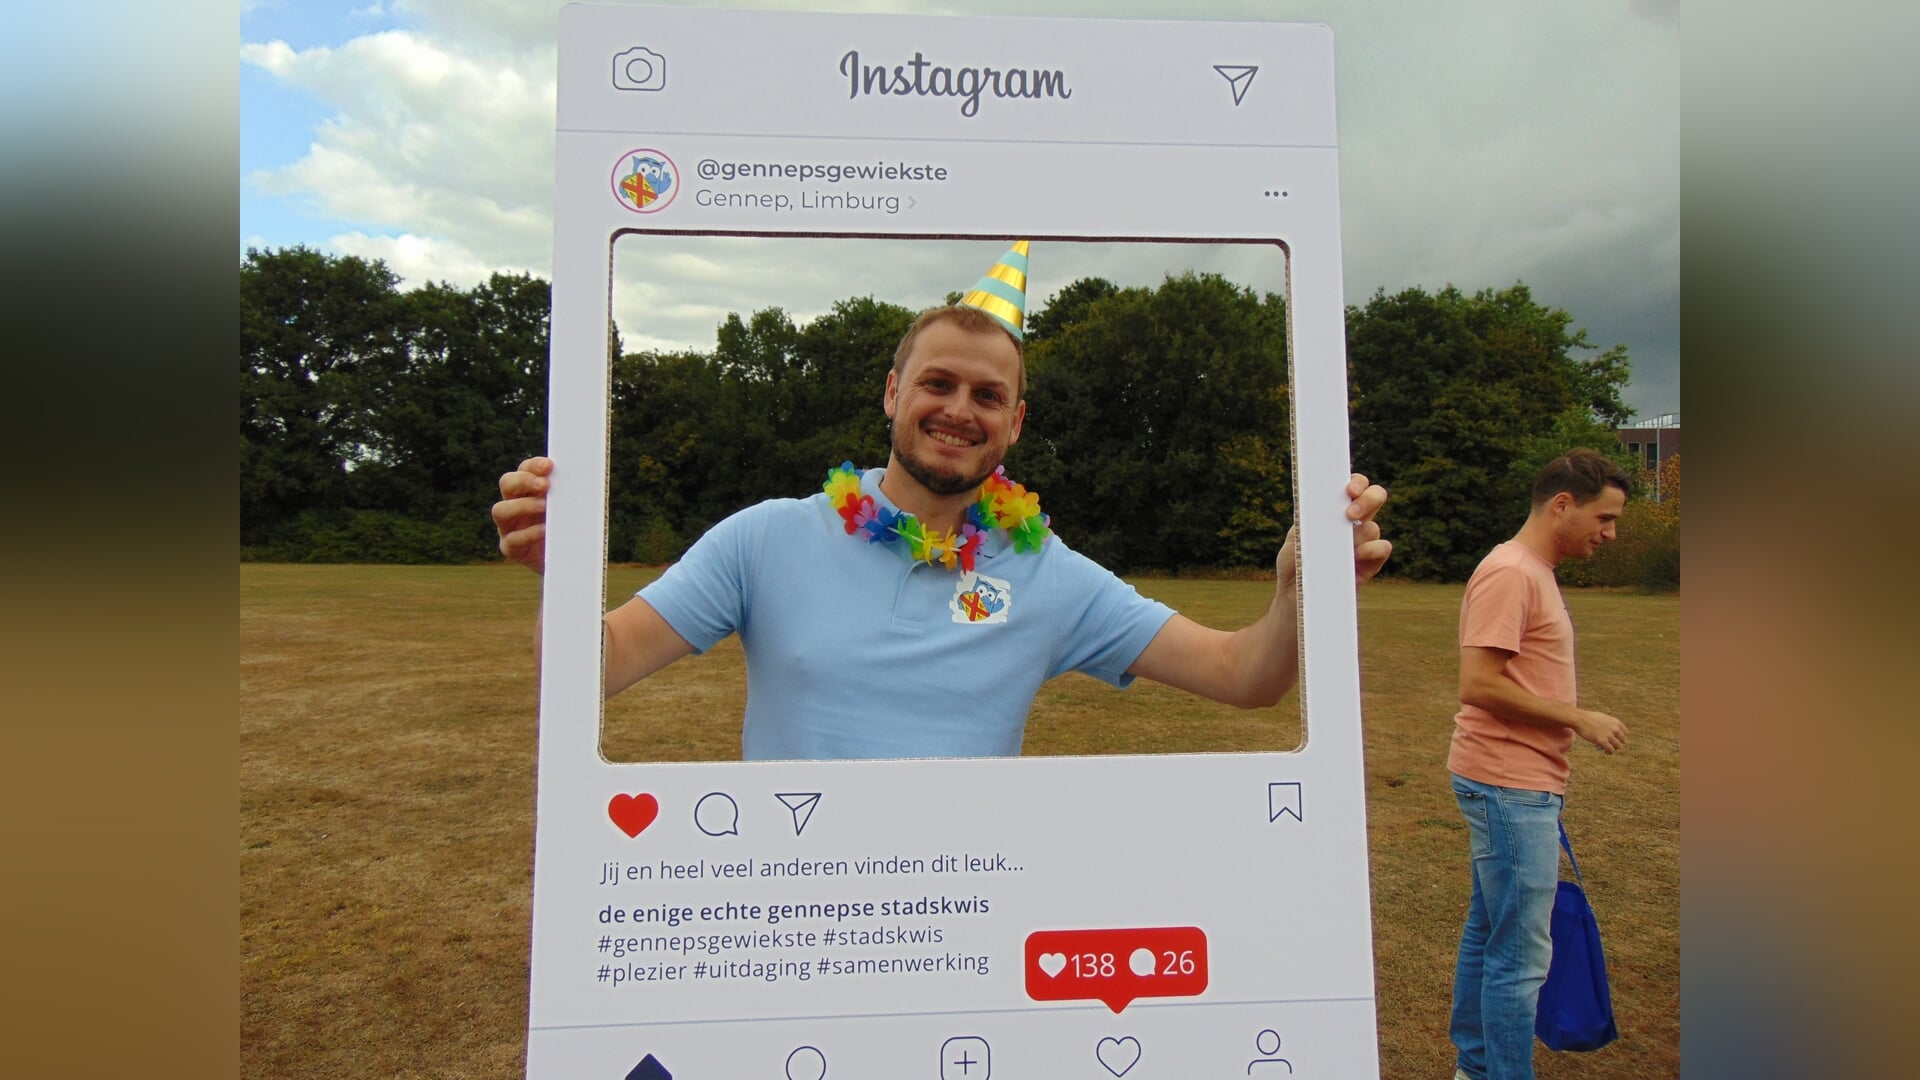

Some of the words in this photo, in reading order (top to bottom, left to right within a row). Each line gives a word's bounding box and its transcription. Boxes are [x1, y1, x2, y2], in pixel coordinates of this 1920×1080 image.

[840, 51, 1072, 117] Instagram
[697, 159, 947, 182] @gennepsgewiekste
[696, 189, 793, 213] Gennep,
[802, 191, 899, 214] Limburg
[599, 862, 620, 886] Jij
[627, 866, 651, 880] en
[661, 860, 703, 879] heel
[711, 859, 752, 878] veel
[761, 857, 847, 877] anderen
[855, 856, 923, 874] vinden
[932, 854, 958, 872] dit
[965, 853, 1023, 872] leuk...
[599, 905, 625, 923] de
[633, 904, 693, 927] enige
[700, 902, 761, 920] echte
[768, 903, 874, 924] gennepse
[881, 896, 989, 916] stadskwis
[598, 929, 816, 956] #gennepsgewiekste
[823, 925, 942, 946] #stadskwis
[597, 961, 688, 987] #plezier
[693, 959, 810, 982] #uitdaging
[817, 952, 989, 975] #samenwerking
[1071, 953, 1115, 977] 138
[1163, 951, 1194, 974] 26
